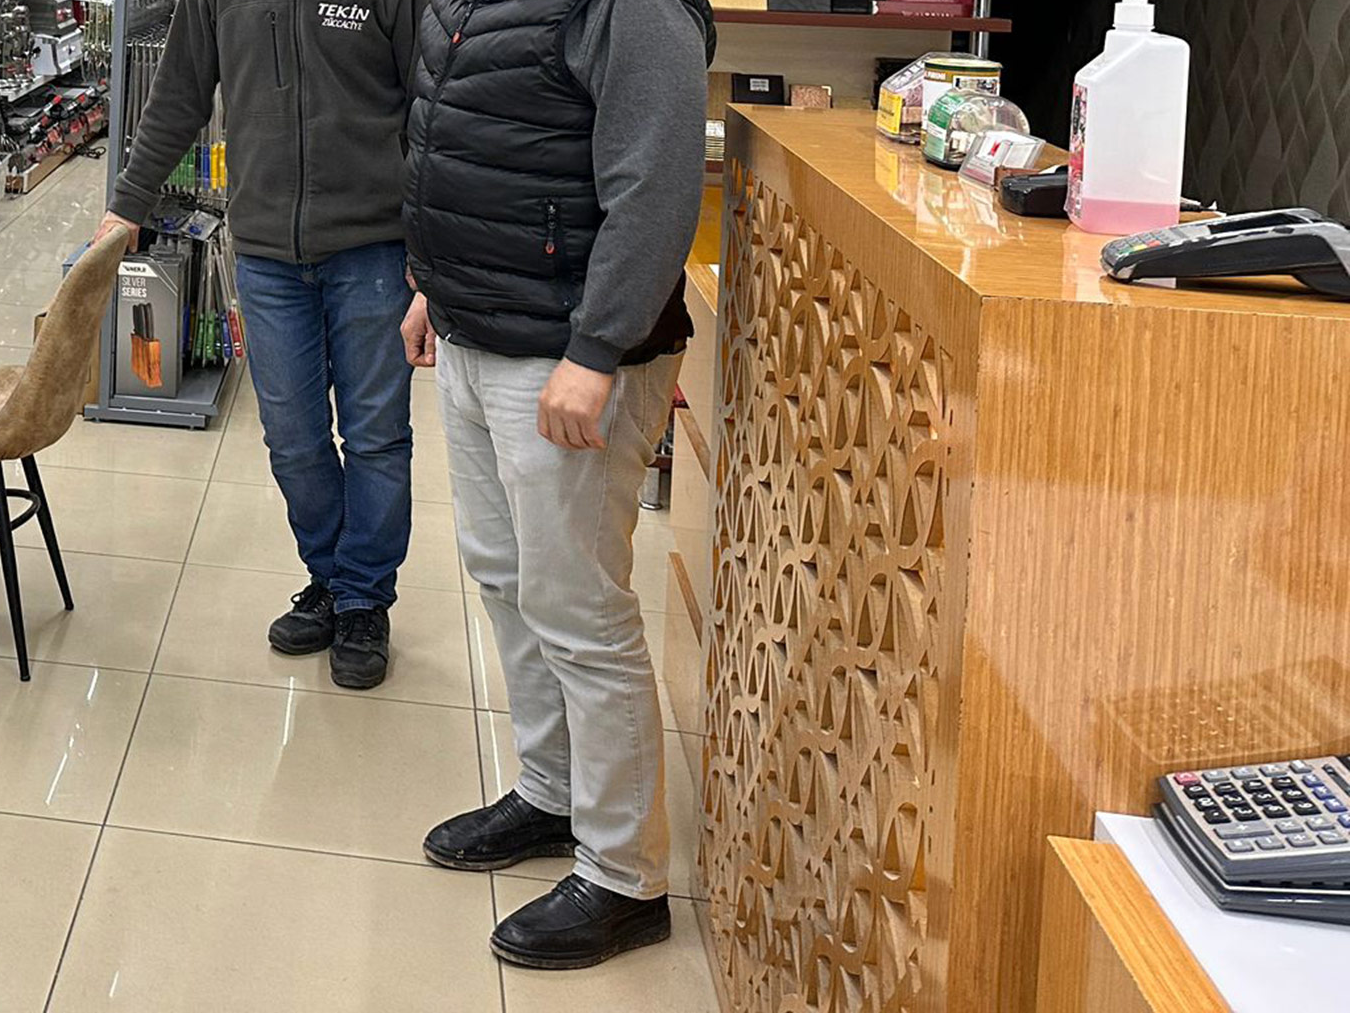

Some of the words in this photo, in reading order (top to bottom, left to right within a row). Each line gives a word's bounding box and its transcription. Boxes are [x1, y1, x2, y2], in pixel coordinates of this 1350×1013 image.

[318, 3, 370, 20] TEKİN
[121, 276, 146, 287] SILVER
[121, 287, 147, 298] SERIES
